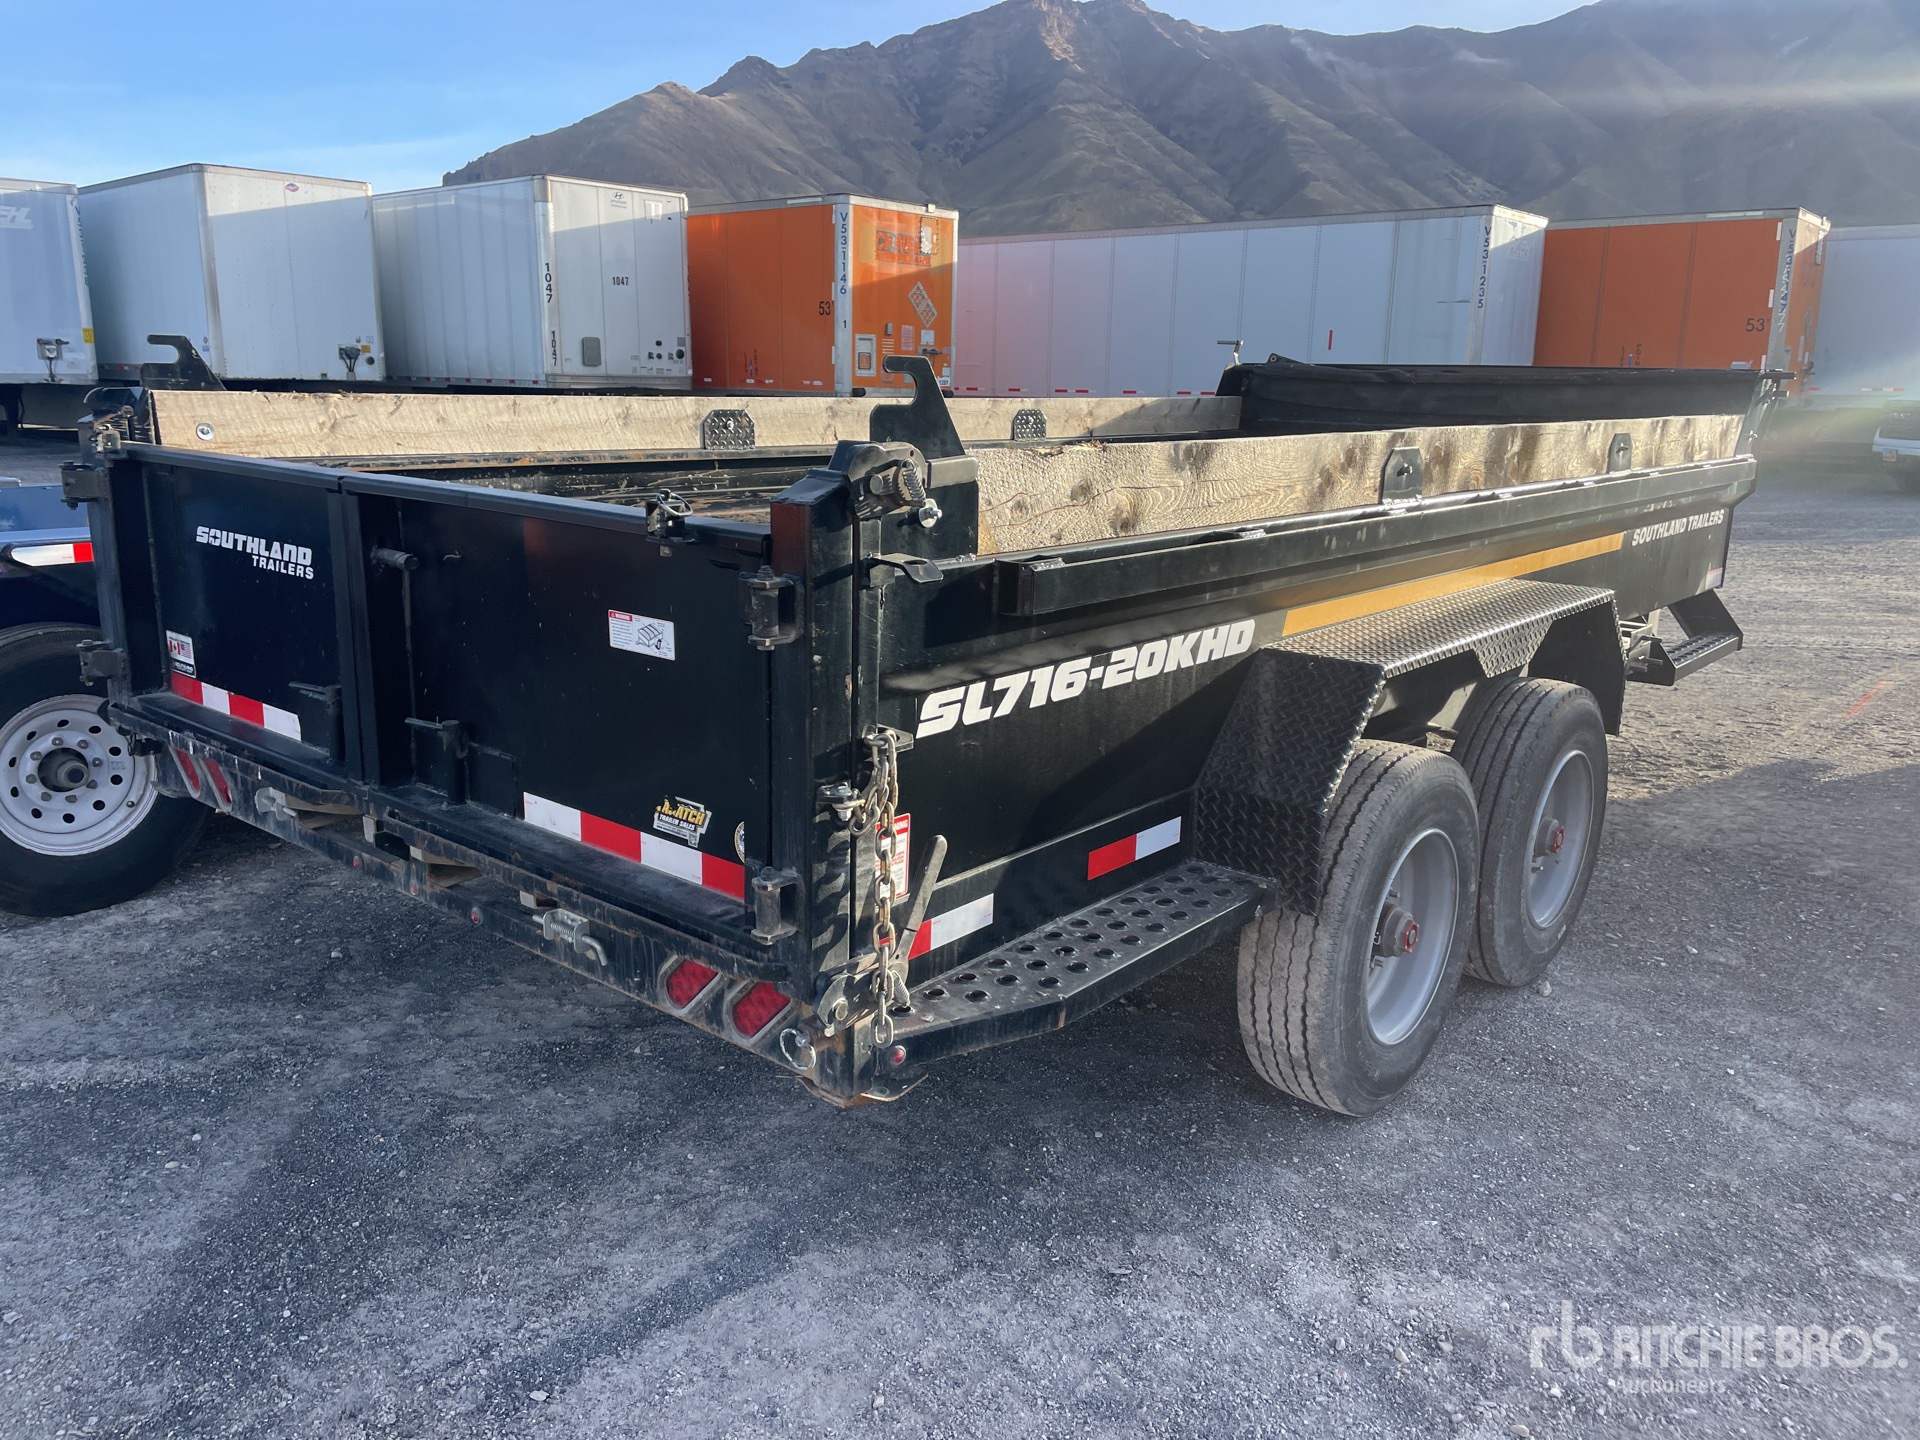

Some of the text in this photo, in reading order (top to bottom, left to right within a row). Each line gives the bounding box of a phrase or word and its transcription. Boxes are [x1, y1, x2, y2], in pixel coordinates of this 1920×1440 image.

[545, 262, 553, 304] 1047
[612, 276, 629, 286] 1047
[196, 525, 312, 566] SOUTHLAND
[1631, 509, 1725, 547] SOUTHLAND TRAILERS
[252, 555, 314, 580] TRAILERS
[915, 619, 1256, 739] SL716-20KHD
